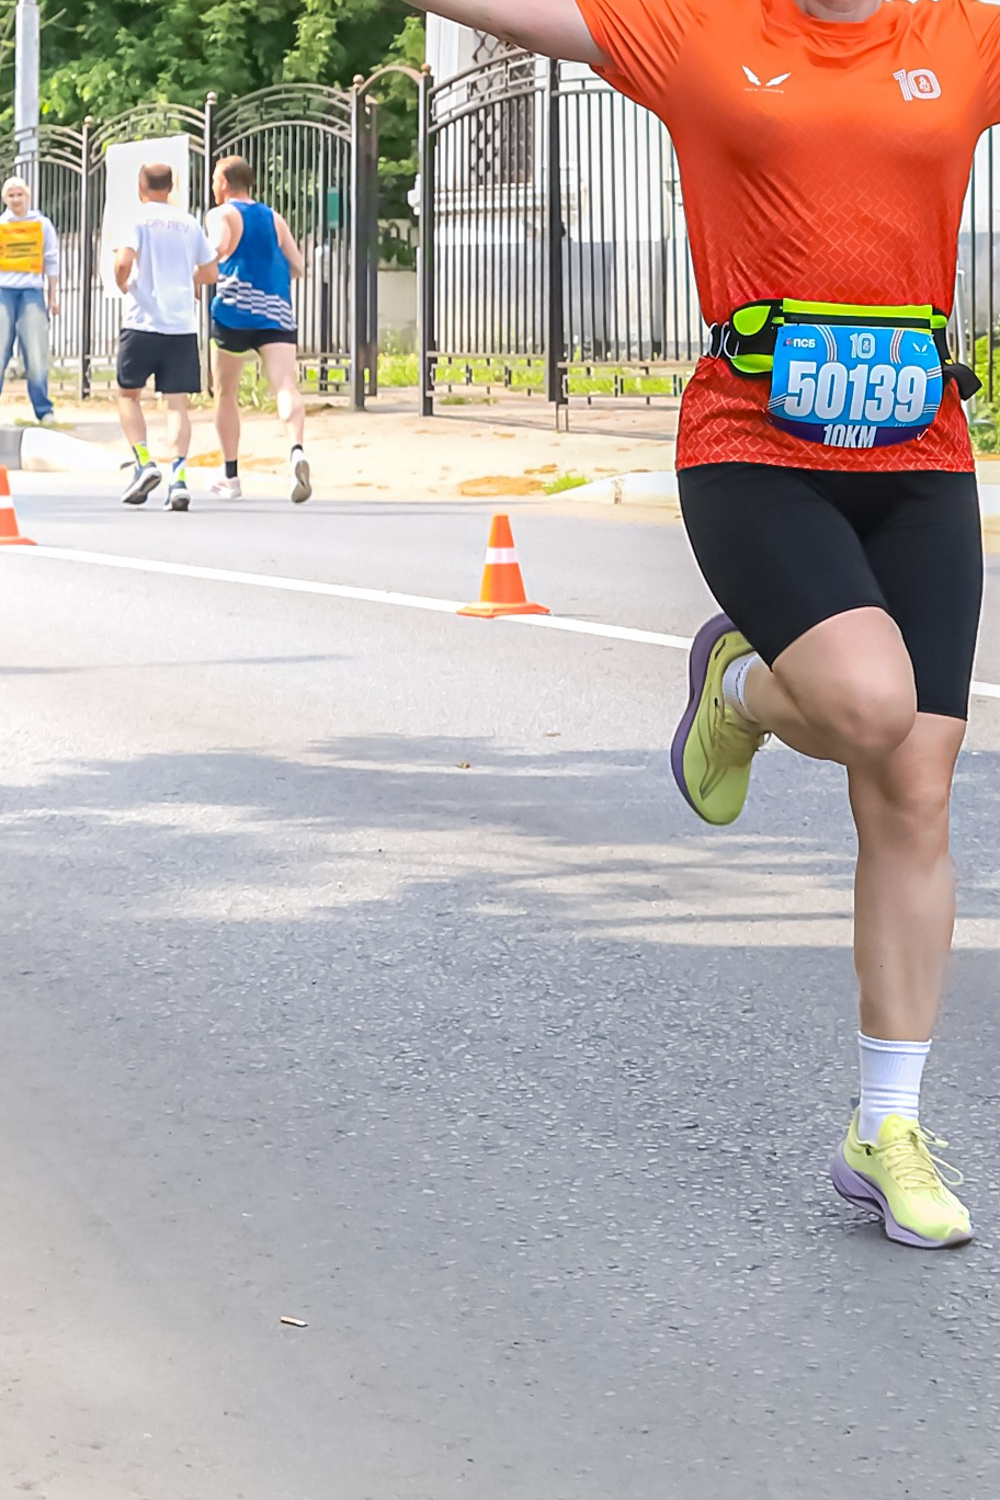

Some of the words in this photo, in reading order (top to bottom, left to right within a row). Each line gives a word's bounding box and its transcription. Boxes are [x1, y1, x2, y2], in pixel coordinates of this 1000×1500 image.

[892, 68, 942, 101] 10
[793, 338, 816, 348] ПСБ
[850, 333, 876, 359] 10
[783, 360, 928, 422] 50139
[823, 423, 877, 449] 10KM
